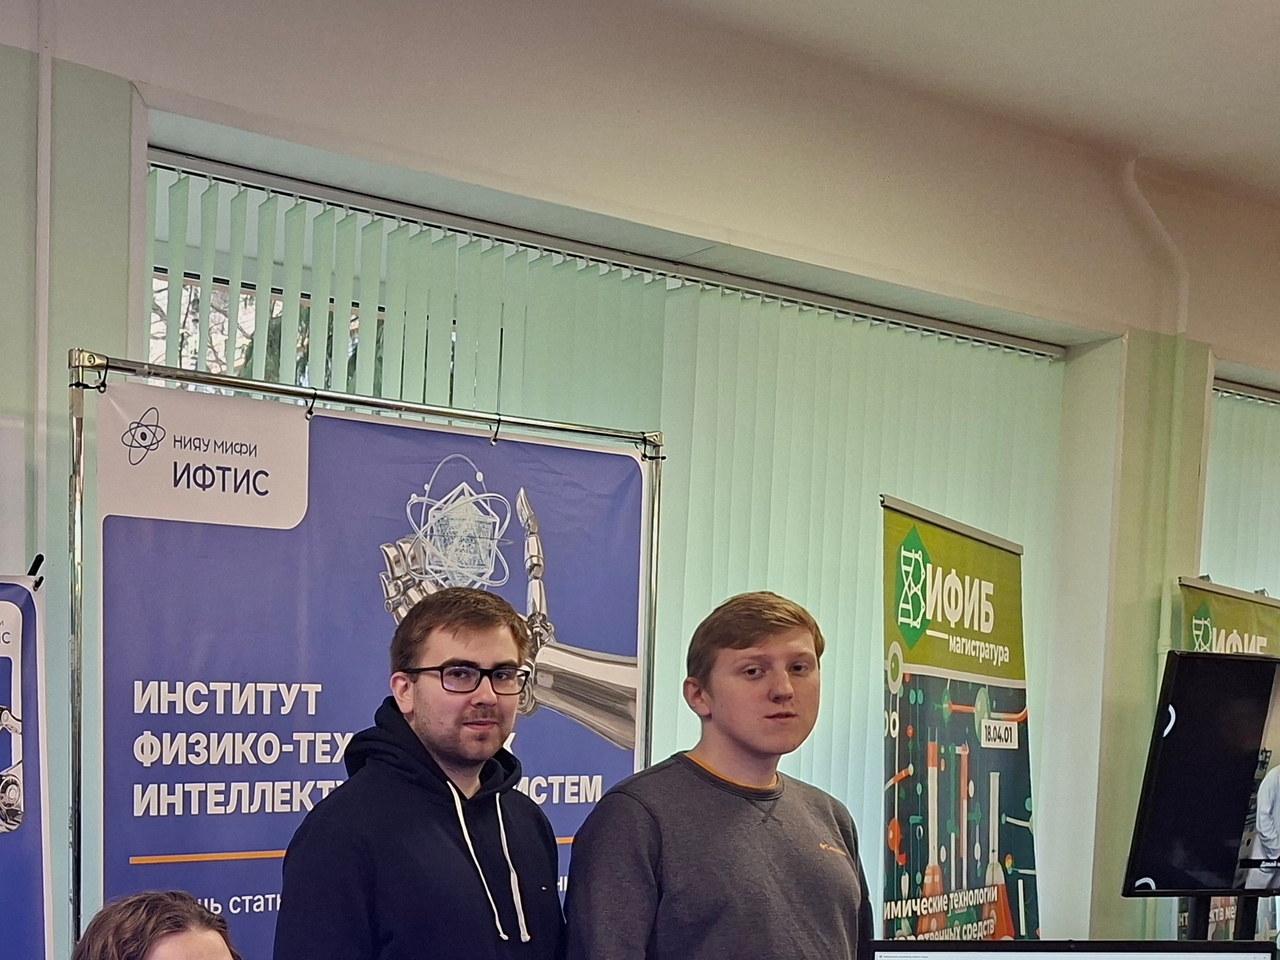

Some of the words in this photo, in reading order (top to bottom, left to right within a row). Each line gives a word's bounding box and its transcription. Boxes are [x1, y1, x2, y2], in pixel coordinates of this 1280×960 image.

[173, 435, 210, 454] НИЯУ
[213, 439, 258, 457] МИФИ
[171, 460, 270, 498] ИФТИС
[926, 563, 994, 634] ИФИБ
[949, 634, 1010, 667] магистратура
[132, 680, 322, 716] ИНСТИТУТ
[132, 730, 353, 767] ФИЗИКО-ТЕХ
[984, 724, 1013, 744] 18.04.01
[132, 782, 340, 818] ИНТЕЛЛЕКТ
[513, 775, 603, 805] ИСТЕМ
[883, 894, 948, 921] имические
[949, 886, 998, 910] технологии
[962, 918, 995, 939] средств
